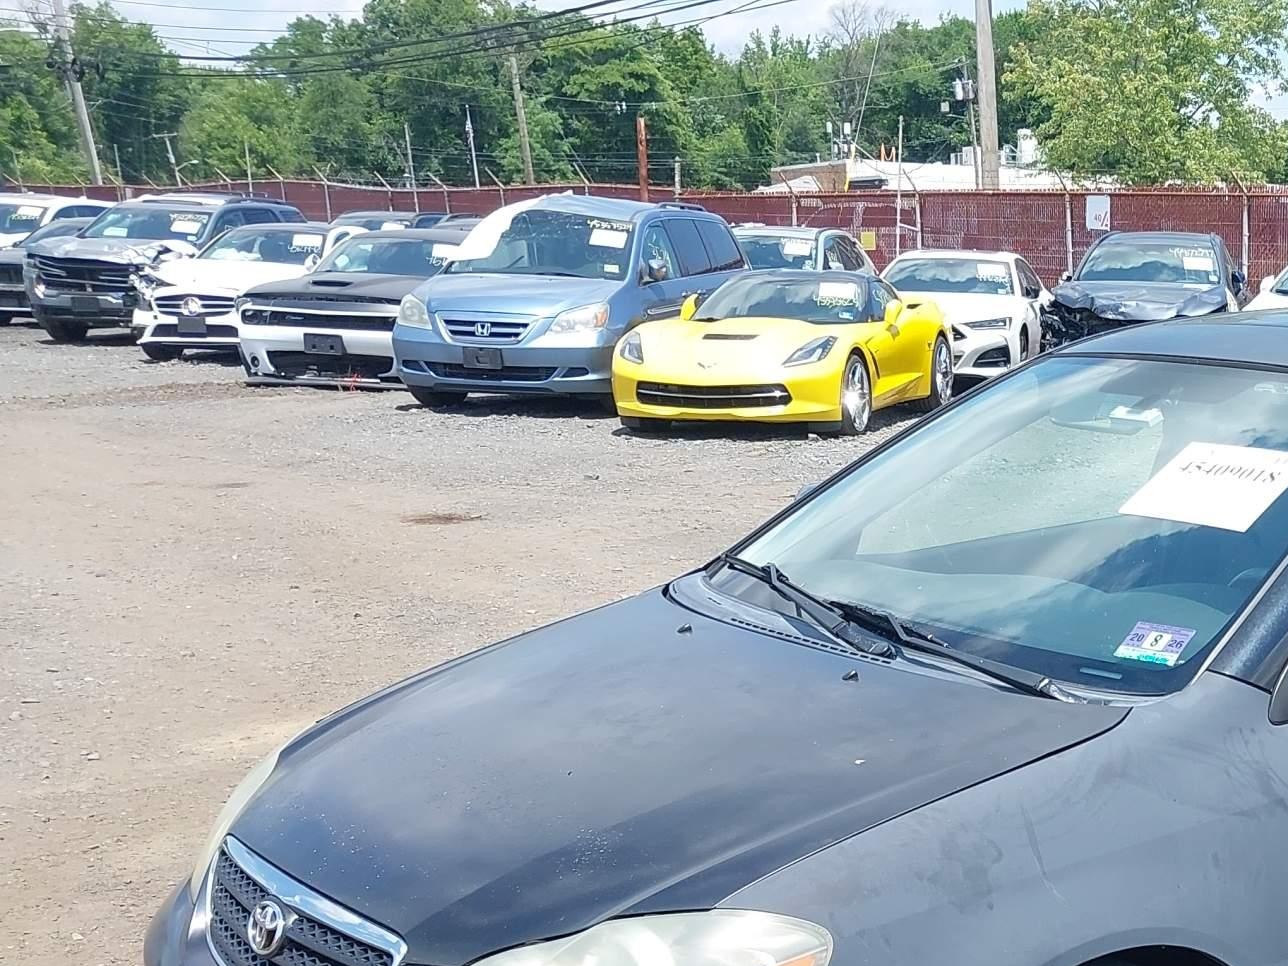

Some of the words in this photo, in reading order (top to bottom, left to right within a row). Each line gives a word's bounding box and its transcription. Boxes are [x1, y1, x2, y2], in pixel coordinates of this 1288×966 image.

[1129, 632, 1145, 642] 20
[1150, 633, 1164, 648] 8
[1168, 639, 1185, 649] 26
